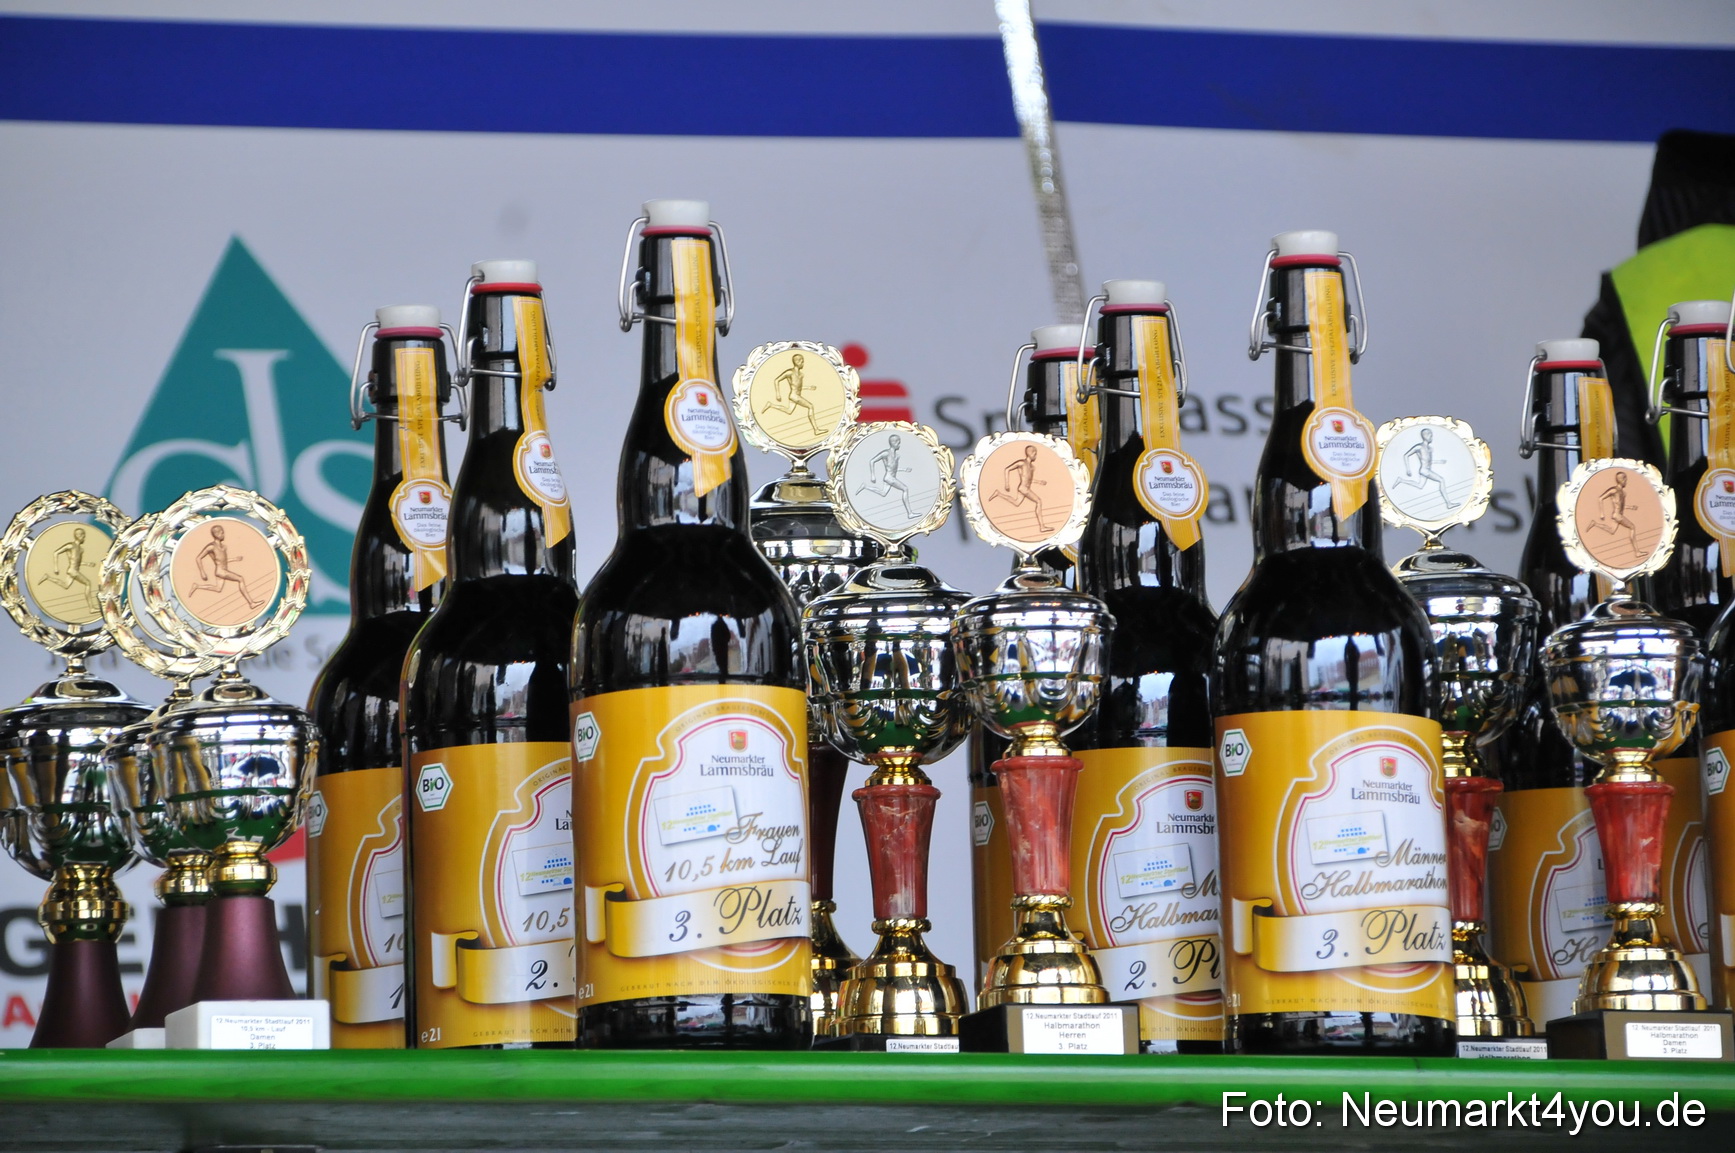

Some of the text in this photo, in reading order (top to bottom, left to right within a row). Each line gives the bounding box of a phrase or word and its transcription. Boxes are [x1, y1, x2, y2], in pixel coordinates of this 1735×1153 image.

[1318, 441, 1365, 450] Lammsbräu
[1149, 481, 1193, 489] Lammsbräu
[711, 754, 765, 765] Neumarkter
[532, 765, 567, 787] ORIGINAL
[700, 763, 774, 777] Lammsbräu
[1362, 780, 1413, 791] Neumarkter
[1351, 788, 1421, 805] Lammsbräu
[725, 812, 801, 845] Frauen
[1156, 822, 1216, 835] Lammsbr
[664, 838, 804, 884] 10,5 km Lauf
[1301, 866, 1447, 901] Halbmarathon
[522, 906, 571, 934] 10,5
[668, 885, 803, 943] 3. Platz
[1316, 909, 1447, 960] 3. Platz
[526, 959, 559, 992] 2.
[1124, 960, 1157, 992] 2.
[666, 980, 693, 988] NACH
[1073, 1012, 1102, 1020] Stadtlauf
[1102, 1012, 1118, 1020] 2011
[1043, 1021, 1101, 1030] Halbmarathon
[1059, 1031, 1087, 1039] Herren
[934, 1042, 959, 1050] Stadtlau
[1505, 1045, 1532, 1053] Stadtlauf
